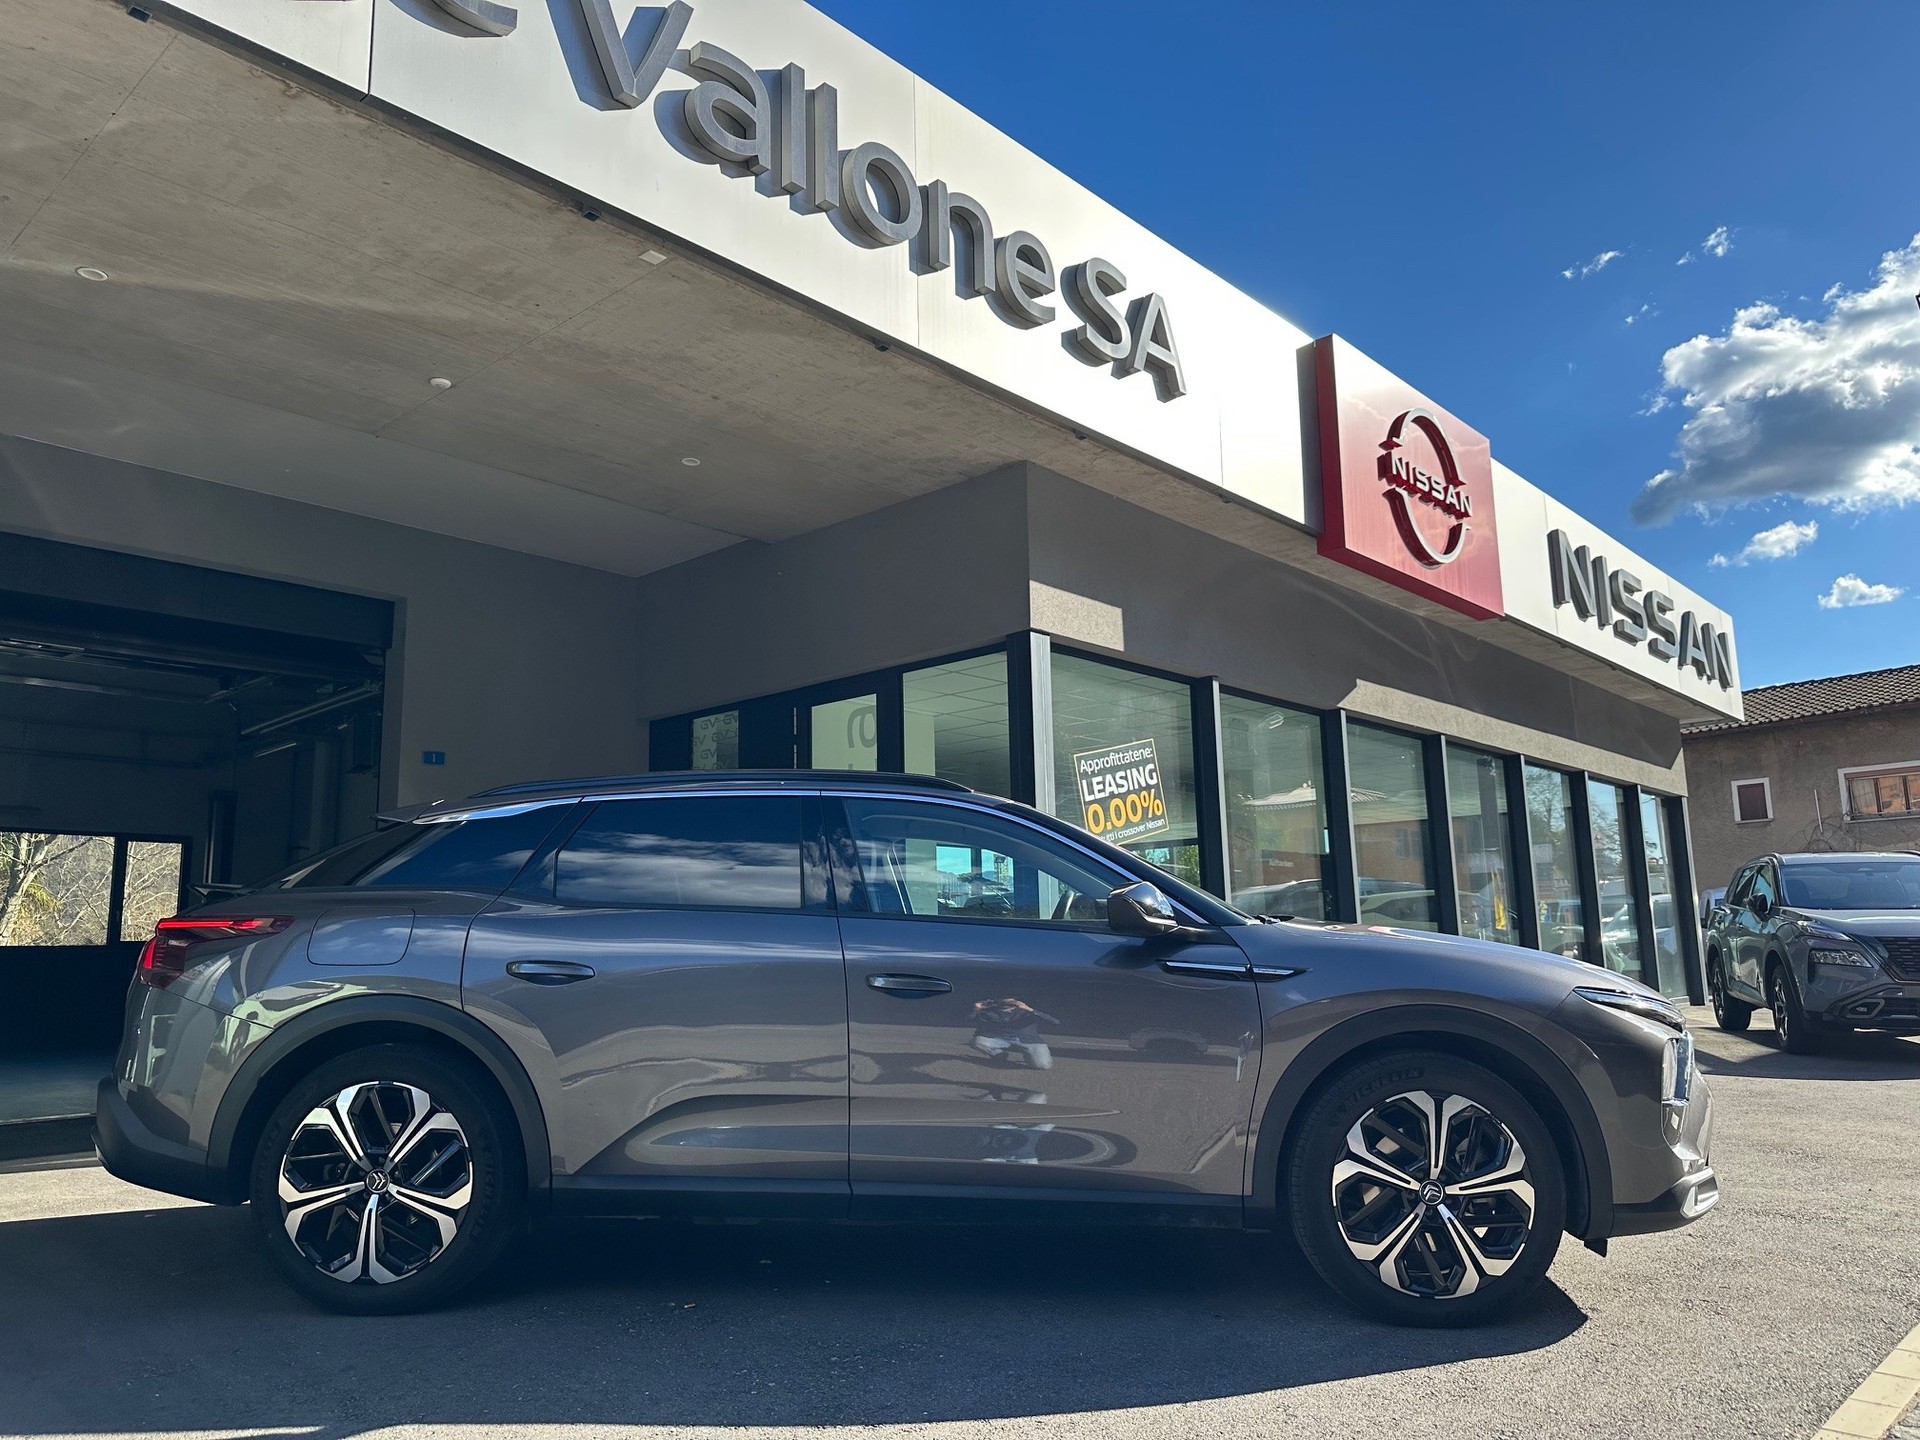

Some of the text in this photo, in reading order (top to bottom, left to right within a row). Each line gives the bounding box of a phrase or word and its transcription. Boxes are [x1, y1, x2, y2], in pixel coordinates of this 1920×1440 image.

[572, 0, 1186, 402] Vallone SA
[1388, 455, 1473, 517] NISSAN
[1547, 529, 1734, 691] NISSAN
[1080, 747, 1153, 775] Approfittatene:
[1081, 763, 1158, 802] LEASING
[1087, 788, 1163, 834] 0.00%
[1118, 824, 1146, 839] crossover
[1146, 818, 1166, 830] Nissan
